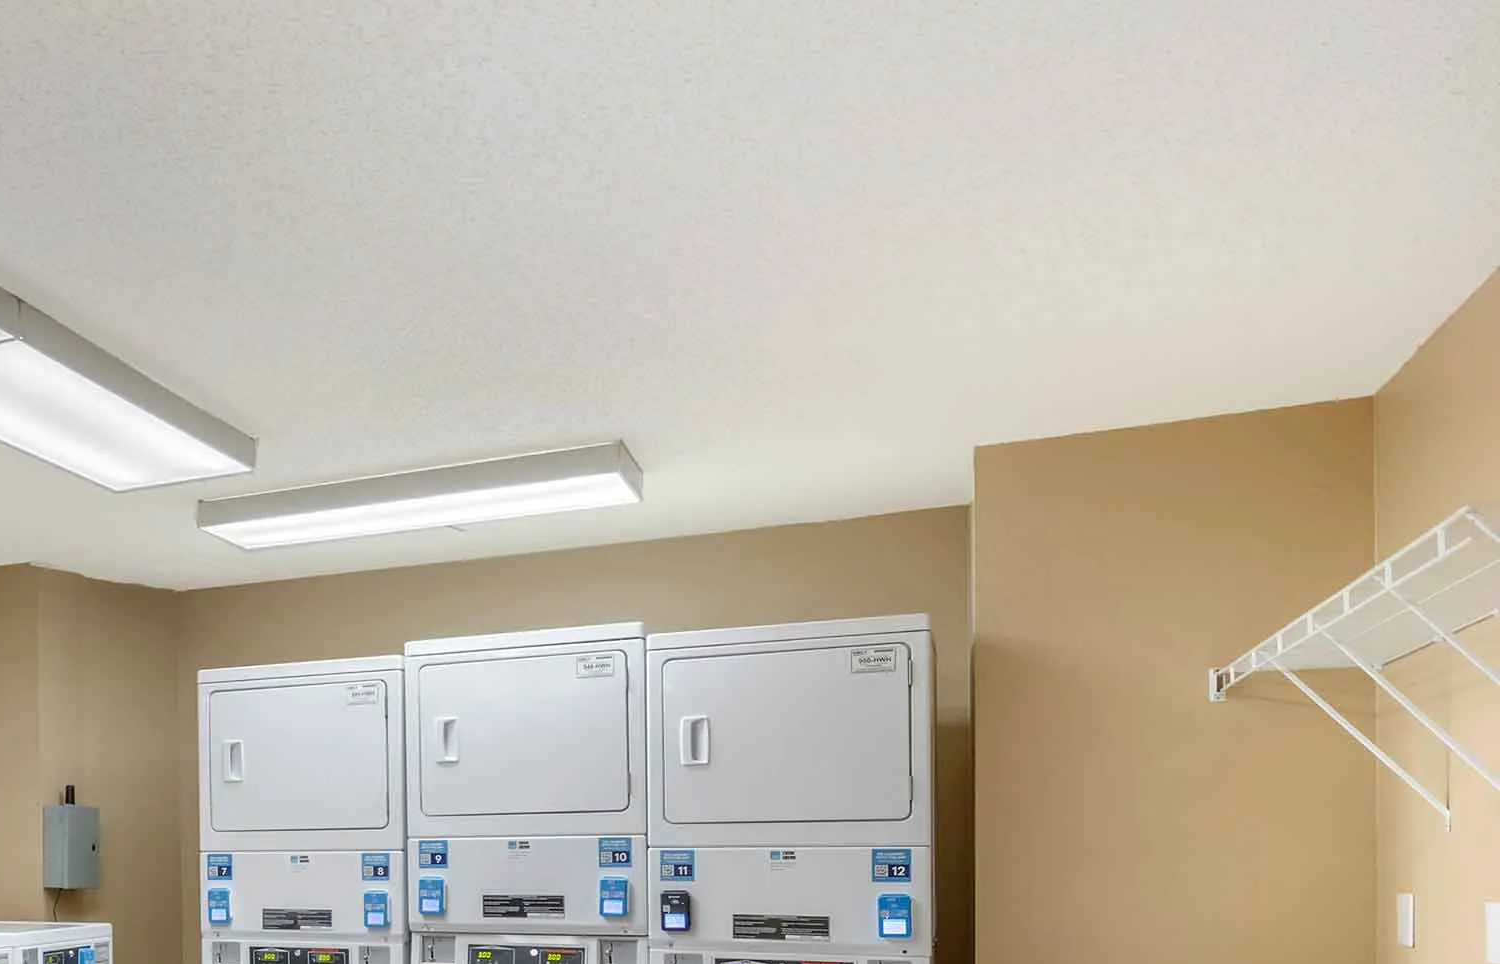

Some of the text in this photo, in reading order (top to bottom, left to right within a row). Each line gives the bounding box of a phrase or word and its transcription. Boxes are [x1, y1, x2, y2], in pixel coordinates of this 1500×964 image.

[435, 855, 442, 863] 9
[614, 852, 627, 862] 10
[221, 867, 228, 876] 7
[377, 867, 385, 876] 8
[678, 866, 688, 875] 11
[892, 866, 905, 876] 12
